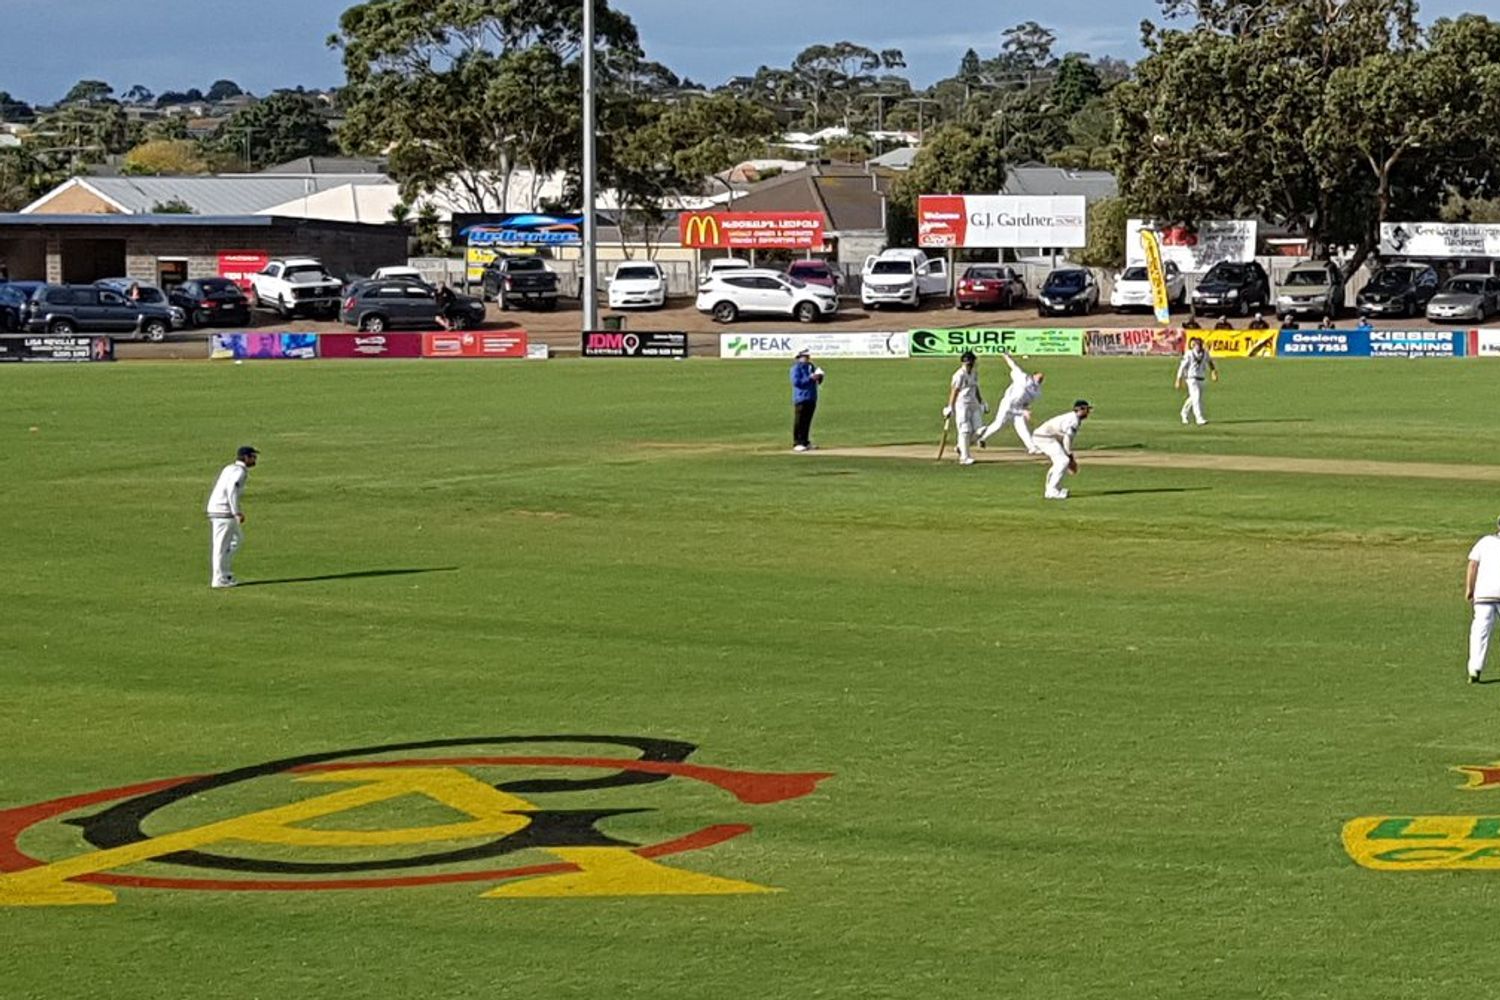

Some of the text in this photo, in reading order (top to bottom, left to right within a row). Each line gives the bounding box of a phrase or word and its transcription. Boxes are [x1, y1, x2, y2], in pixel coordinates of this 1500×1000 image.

[589, 333, 624, 349] JDM
[750, 337, 792, 350] PEAK
[948, 331, 1016, 345] SURF
[946, 345, 1017, 354] JUNCTION
[1370, 342, 1453, 351] TRAINING
